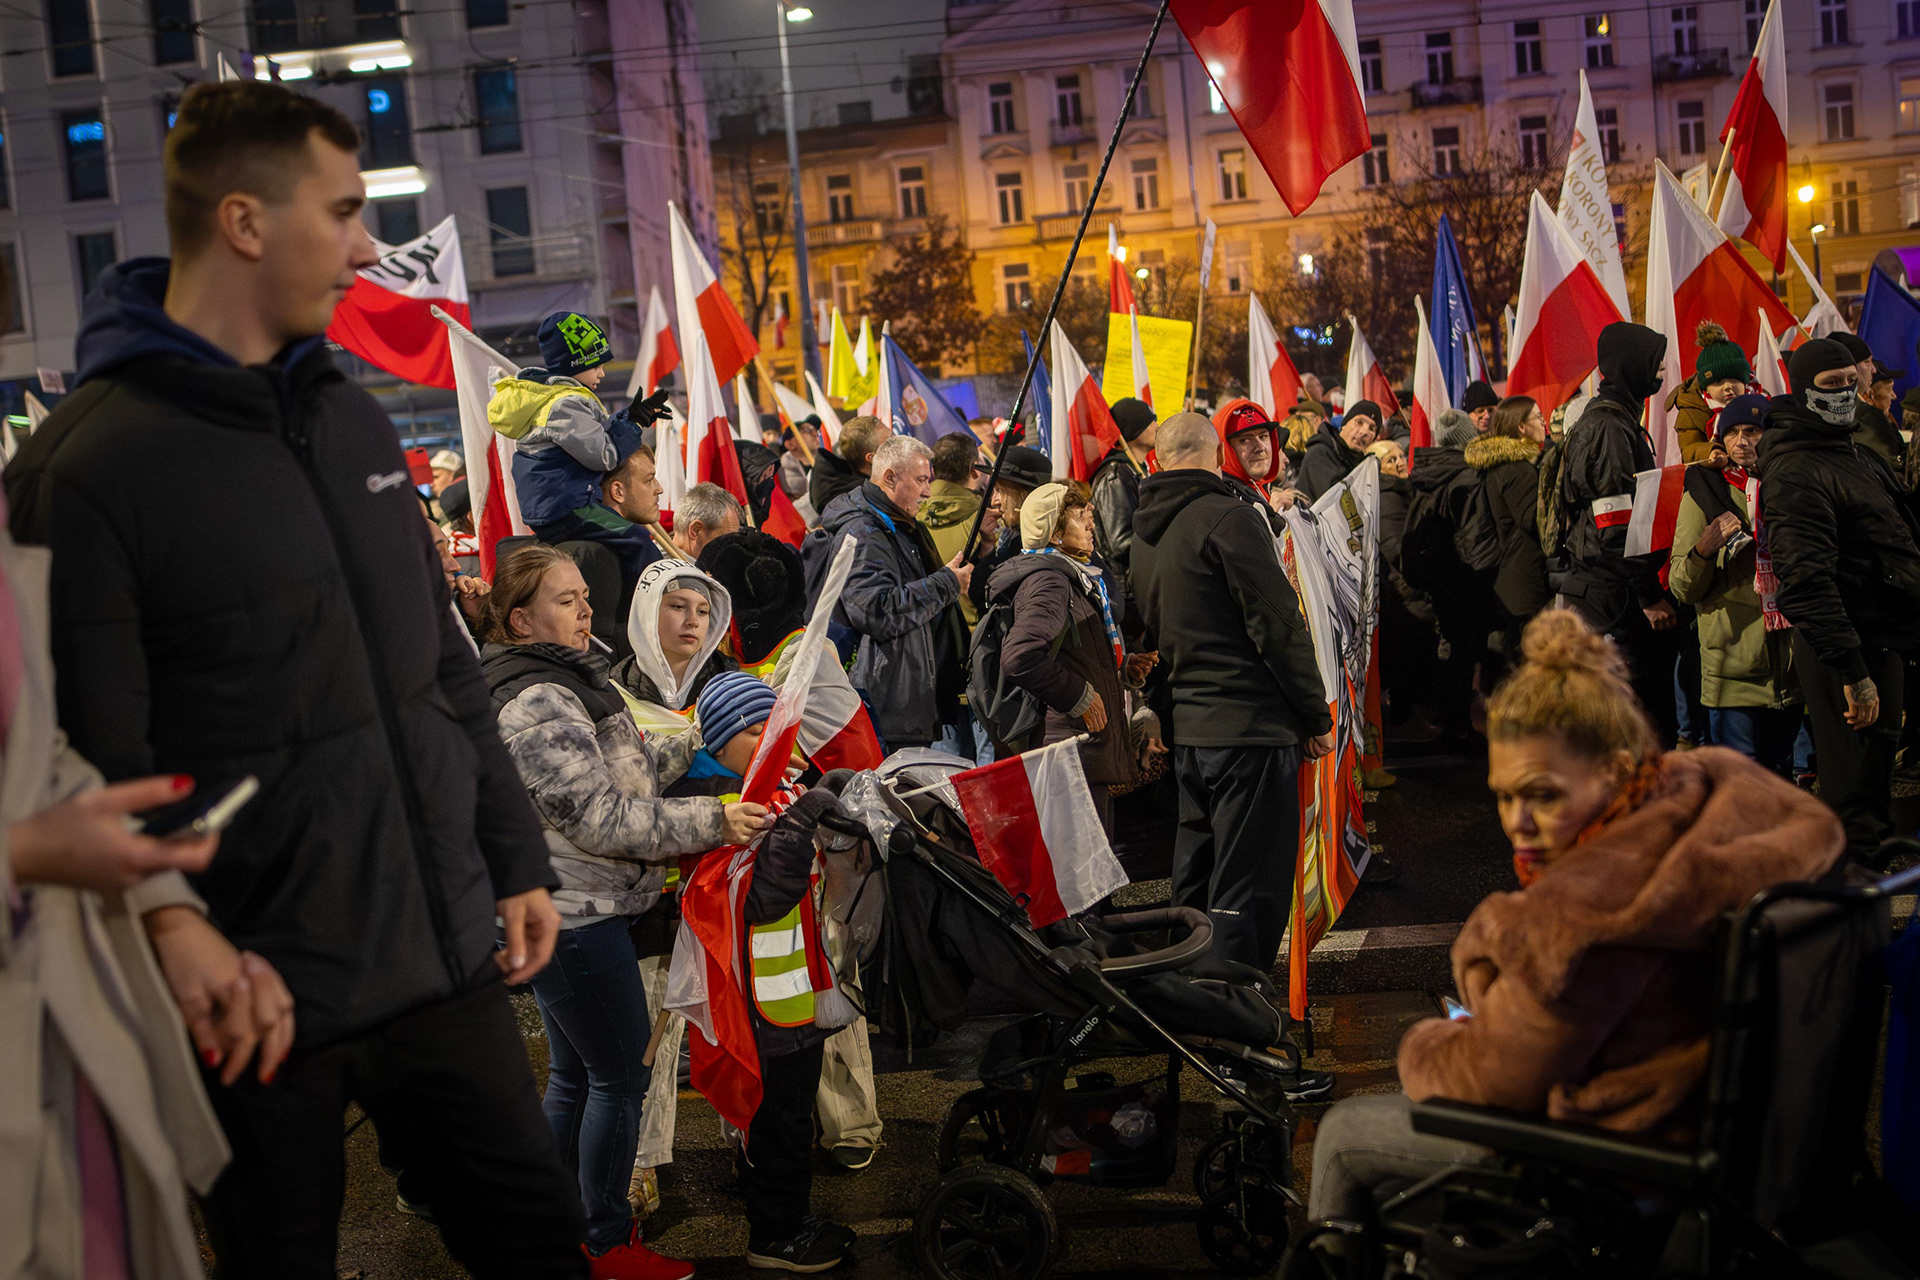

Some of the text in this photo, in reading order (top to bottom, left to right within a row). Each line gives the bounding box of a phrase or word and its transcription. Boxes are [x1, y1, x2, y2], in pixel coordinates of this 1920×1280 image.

[1558, 197, 1584, 230] OWY
[1565, 170, 1615, 237] KORONY
[1069, 1016, 1099, 1047] lionelo
